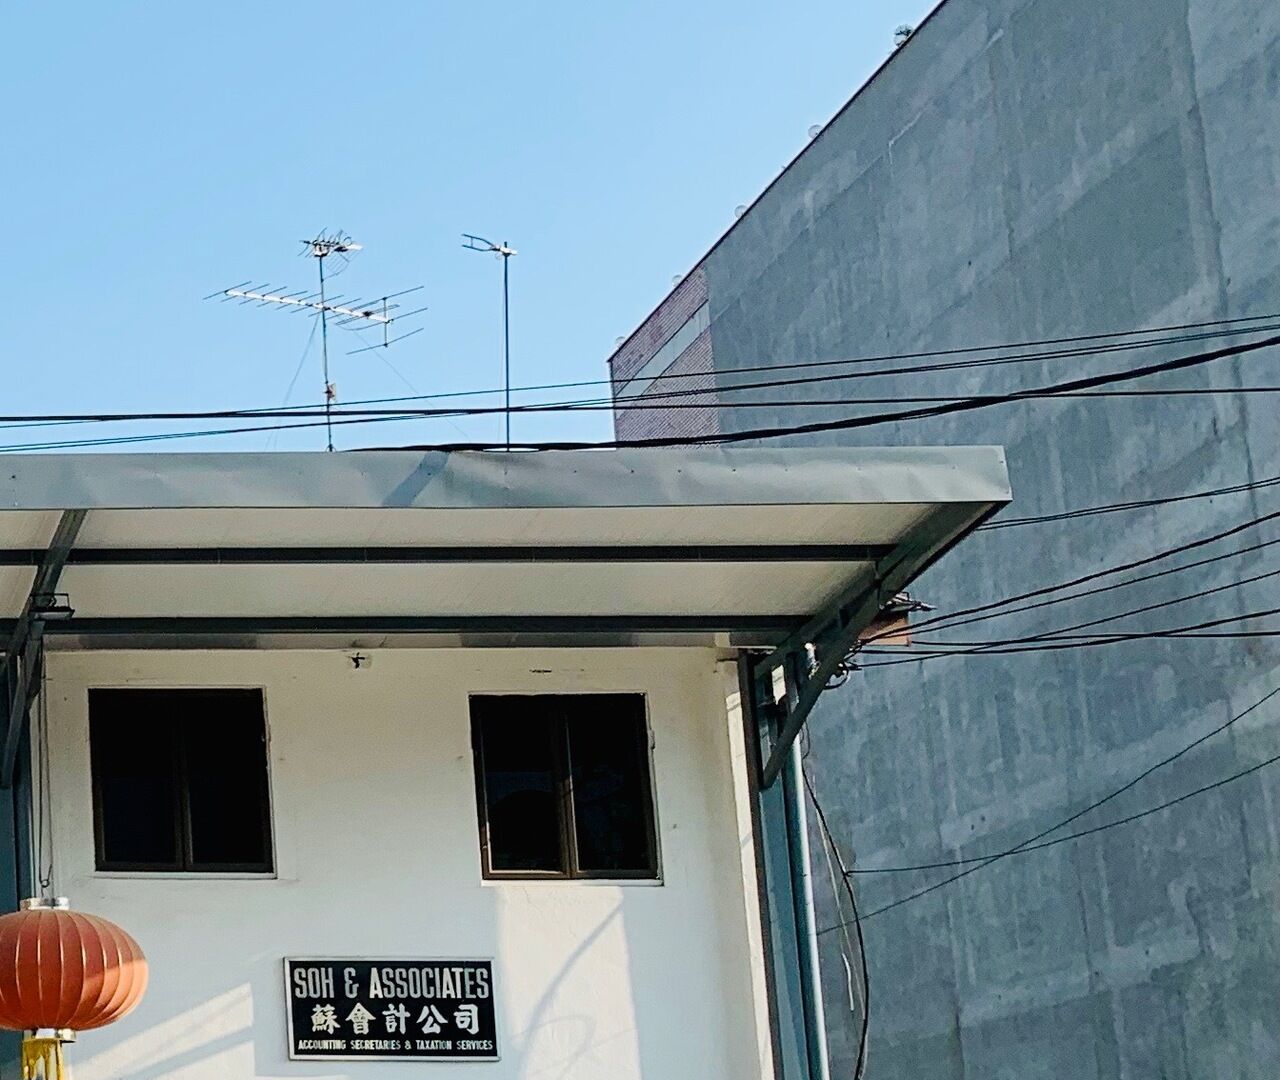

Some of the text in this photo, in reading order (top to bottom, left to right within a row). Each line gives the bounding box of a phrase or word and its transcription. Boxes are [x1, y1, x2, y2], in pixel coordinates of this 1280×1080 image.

[293, 967, 489, 999] SOH & ASSOCIATES
[310, 1002, 481, 1035] 蘇會計公司
[297, 1039, 347, 1051] ACCOUNTING
[404, 1040, 412, 1050] &
[415, 1039, 453, 1051] TAXATION
[456, 1039, 494, 1051] SERVICES
